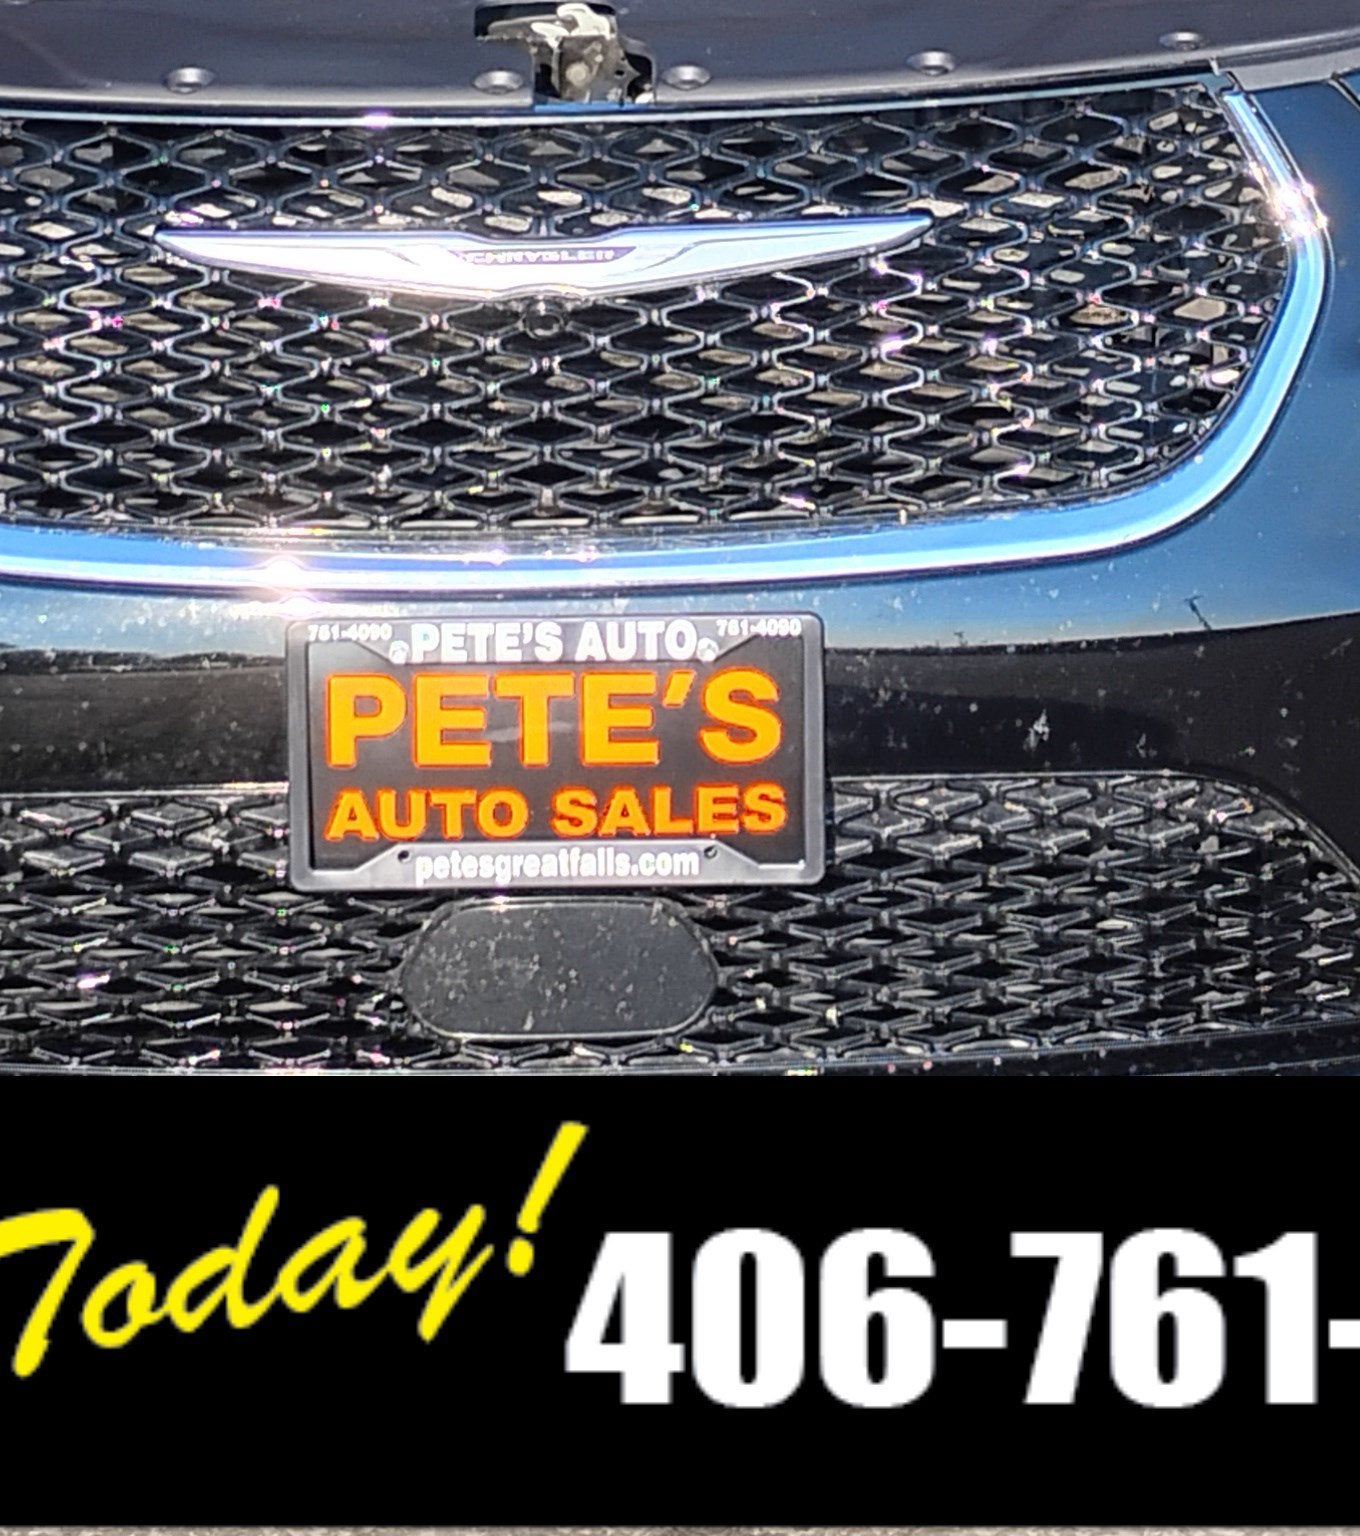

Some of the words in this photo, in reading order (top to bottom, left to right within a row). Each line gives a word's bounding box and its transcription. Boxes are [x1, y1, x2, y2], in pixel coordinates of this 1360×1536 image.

[307, 622, 393, 642] 761-4090
[409, 621, 565, 664] PETE'S
[574, 619, 700, 662] AUTO
[716, 617, 802, 637] 761-4090
[324, 665, 784, 769] PETE'S
[322, 785, 530, 841] AUTO
[550, 782, 788, 839] SALES
[414, 846, 700, 886] petesgreatfalls.com
